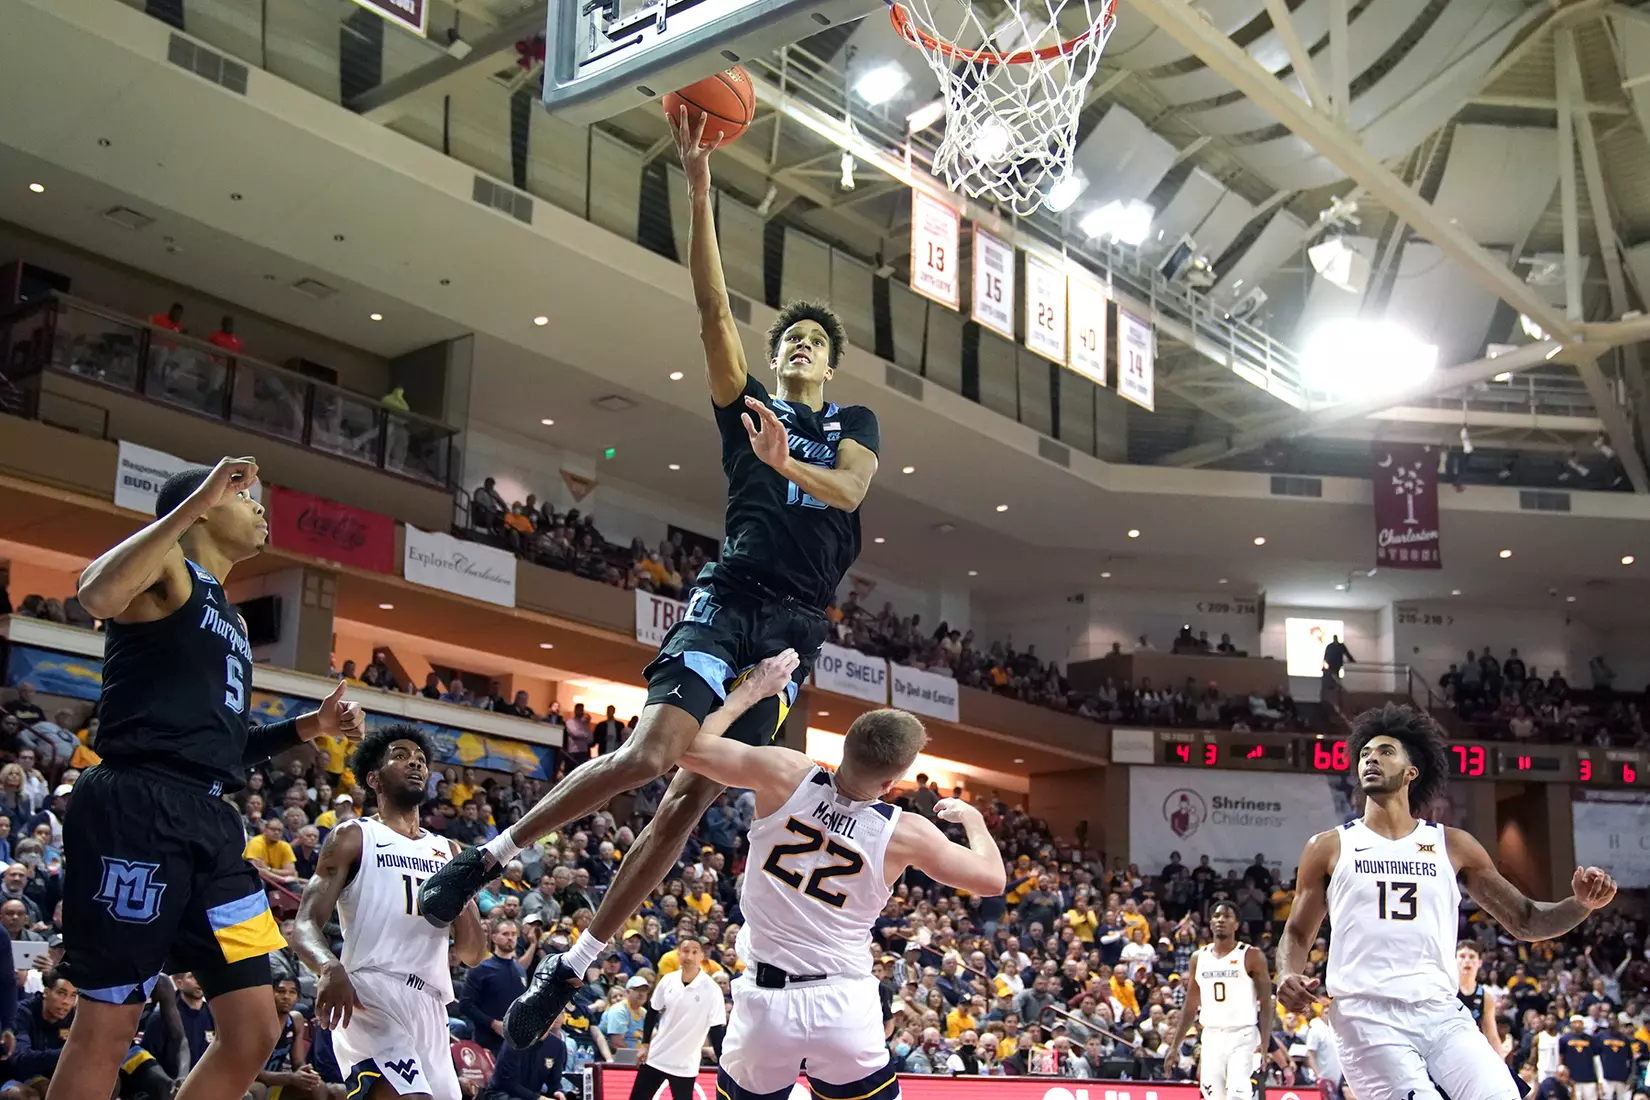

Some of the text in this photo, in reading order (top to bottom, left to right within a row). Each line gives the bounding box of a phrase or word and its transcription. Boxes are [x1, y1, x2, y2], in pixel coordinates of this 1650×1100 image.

[927, 241, 945, 272] 13
[986, 273, 1002, 303] 15
[1038, 302, 1054, 331] 22
[1080, 326, 1096, 352] 40
[1129, 350, 1143, 378] 14
[124, 475, 151, 493] BUD
[1379, 528, 1438, 547] Charleston
[408, 546, 511, 586] Explore Charleston
[817, 653, 885, 685] TOP SHELF
[224, 653, 245, 714] 5
[1176, 744, 1190, 762] 4
[1204, 744, 1217, 765] 3
[1452, 745, 1486, 776] 73
[1579, 760, 1592, 781] 3
[1623, 763, 1636, 783] 6
[1212, 796, 1282, 812] Shriners
[762, 816, 864, 910] 22
[1354, 859, 1437, 877] MOUNTAINEERS
[92, 855, 167, 924] MU
[1376, 880, 1418, 921] 13
[1213, 981, 1226, 1002] 0
